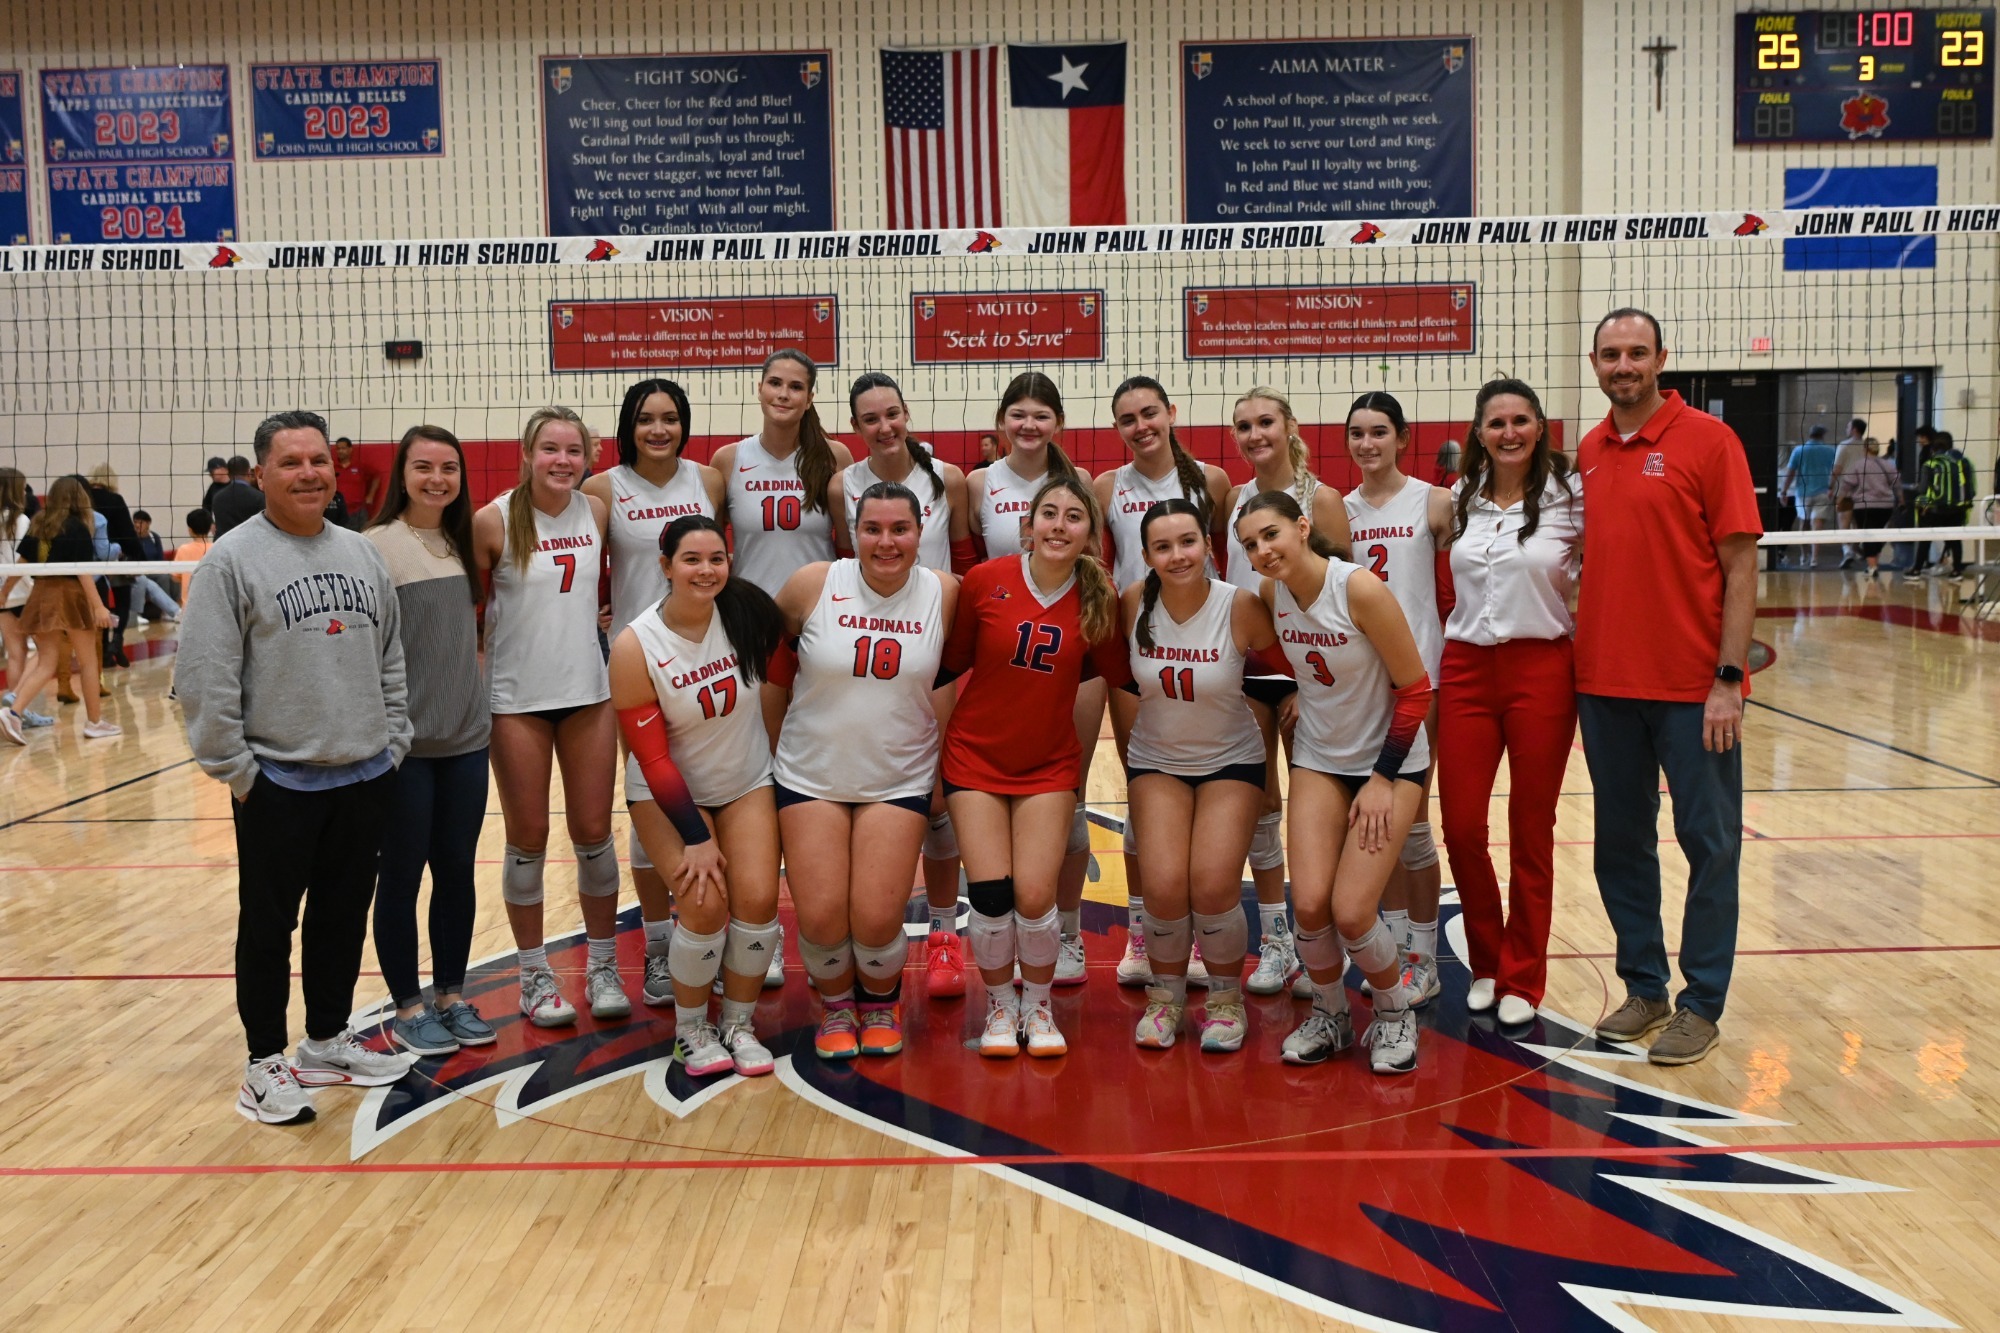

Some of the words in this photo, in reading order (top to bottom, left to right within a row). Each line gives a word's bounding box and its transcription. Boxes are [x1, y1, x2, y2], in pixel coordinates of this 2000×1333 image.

[1755, 16, 1795, 31] HOME
[1857, 12, 1912, 46] 1:00
[1935, 14, 1982, 28] VISITOR
[1759, 34, 1800, 69] 25
[1941, 31, 1983, 66] 23
[1270, 59, 1318, 74] ALMA
[1326, 57, 1384, 72] MATER
[1859, 56, 1874, 81] 3
[46, 73, 112, 95] STATE
[120, 70, 223, 94] CHAMPION
[256, 67, 322, 89] STATE
[331, 65, 434, 87] CHAMPION
[635, 70, 684, 85] FIGHT
[690, 69, 738, 83] SONG
[96, 99, 132, 110] GIRLS
[140, 96, 222, 109] BASKETBALL
[285, 92, 351, 105] CARDINAL
[359, 90, 406, 103] BELLES
[582, 100, 620, 111] Cheer,
[626, 98, 660, 110] Cheer
[665, 98, 681, 109] for
[686, 97, 704, 108] the
[710, 96, 731, 108] Red
[736, 96, 756, 107] and
[762, 95, 792, 106] Blue!
[1224, 96, 1232, 106] A
[1238, 94, 1274, 106] school
[1280, 94, 1291, 105] of
[1296, 93, 1328, 108] hope,
[1333, 96, 1339, 104] a
[1344, 92, 1374, 106] place
[1379, 92, 1390, 103] of
[96, 111, 180, 145] 2023
[305, 105, 390, 139] 2023
[569, 117, 600, 129] We'll
[604, 117, 628, 131] sing
[633, 117, 652, 128] out
[656, 116, 682, 127] loud
[687, 115, 703, 126] for
[708, 116, 728, 125] our
[732, 114, 759, 126] John
[764, 114, 788, 124] Paul
[1214, 119, 1228, 130] O'
[1233, 118, 1259, 130] John
[1264, 117, 1288, 128] Paul
[1309, 119, 1335, 130] your
[1340, 116, 1388, 130] strength
[1392, 116, 1407, 125] we
[68, 150, 96, 160] JOHN
[100, 149, 123, 158] PAUL
[127, 149, 134, 157] II
[137, 147, 163, 157] HIGH
[167, 146, 209, 157] SCHOOL
[277, 144, 306, 154] JOHN
[308, 143, 333, 153] PAUL
[337, 143, 343, 152] II
[345, 142, 373, 152] HIGH
[376, 141, 420, 151] SCHOOL
[52, 168, 118, 190] STATE
[126, 166, 228, 188] CHAMPION
[82, 191, 147, 205] CARDINAL
[154, 190, 201, 203] BELLES
[571, 206, 604, 220] Fight!
[613, 206, 646, 220] Fight!
[656, 204, 689, 218] Fight!
[698, 204, 725, 215] With
[731, 203, 744, 214] all
[749, 205, 769, 214] our
[773, 202, 810, 216] might.
[102, 205, 186, 239] 2024
[619, 224, 636, 234] On
[642, 223, 696, 234] Cardinals
[701, 224, 713, 233] to
[718, 222, 762, 234] Victory!
[1411, 222, 1471, 244] JOHN
[1477, 221, 1532, 243] PAUL
[1543, 221, 1558, 242] II
[1563, 220, 1617, 241] HIGH
[1624, 218, 1709, 240] SCHOOL
[1795, 212, 1852, 235] JOHN
[1861, 211, 1914, 233] PAUL
[1923, 211, 1941, 232] II
[1947, 210, 2000, 231] HIGH
[646, 240, 705, 261] JOHN
[712, 239, 766, 260] PAUL
[774, 238, 790, 259] II
[798, 237, 850, 258] HIGH
[858, 234, 942, 257] SCHOOL
[1028, 232, 1087, 254] JOHN
[1094, 231, 1148, 252] PAUL
[1157, 230, 1173, 250] II
[1180, 229, 1234, 250] HIGH
[1241, 226, 1325, 248] SCHOOL
[23, 250, 37, 271] II
[45, 249, 95, 271] HIGH
[101, 248, 185, 270] SCHOOL
[268, 245, 325, 268] JOHN
[334, 244, 386, 266] PAUL
[395, 244, 410, 266] II
[418, 244, 474, 266] HIGH
[478, 242, 561, 265] SCHOOL
[978, 302, 1037, 316] MOTTO
[1297, 295, 1362, 309] MISSION
[661, 308, 713, 323] VISION
[1202, 322, 1212, 331] To
[1216, 321, 1251, 334] develop
[1254, 321, 1286, 330] leaders
[1289, 320, 1309, 329] who
[1312, 321, 1326, 329] are
[1329, 318, 1359, 329] critical
[1362, 317, 1397, 328] thinkers
[1400, 317, 1417, 327] and
[1419, 317, 1457, 327] effective
[584, 332, 598, 343] We
[601, 333, 615, 342] will
[619, 332, 641, 341] make
[653, 329, 696, 341] difference
[700, 329, 708, 340] in
[711, 329, 726, 339] the
[728, 328, 753, 339] world
[757, 328, 767, 343] by
[770, 327, 804, 341] walking
[943, 329, 986, 348] "Seek
[993, 332, 1010, 347] to
[1015, 328, 1072, 347] Serve"
[745, 480, 804, 491] CARDINA
[628, 503, 701, 521] CARDINALS
[761, 496, 801, 531] 10
[528, 535, 592, 552] ARDINALS
[1351, 526, 1413, 542] ARDINALS
[1368, 544, 1388, 582] 2
[553, 554, 576, 593] 7
[276, 573, 379, 631] VOLLEYBALL
[838, 615, 922, 635] CARDINALS
[1009, 621, 1062, 674] 12
[1282, 629, 1348, 648] CARDINALS
[853, 635, 902, 680] 18
[672, 654, 739, 689] CARDINAL
[1306, 651, 1335, 687] 3
[1159, 666, 1194, 702] 11
[697, 675, 737, 720] 17
